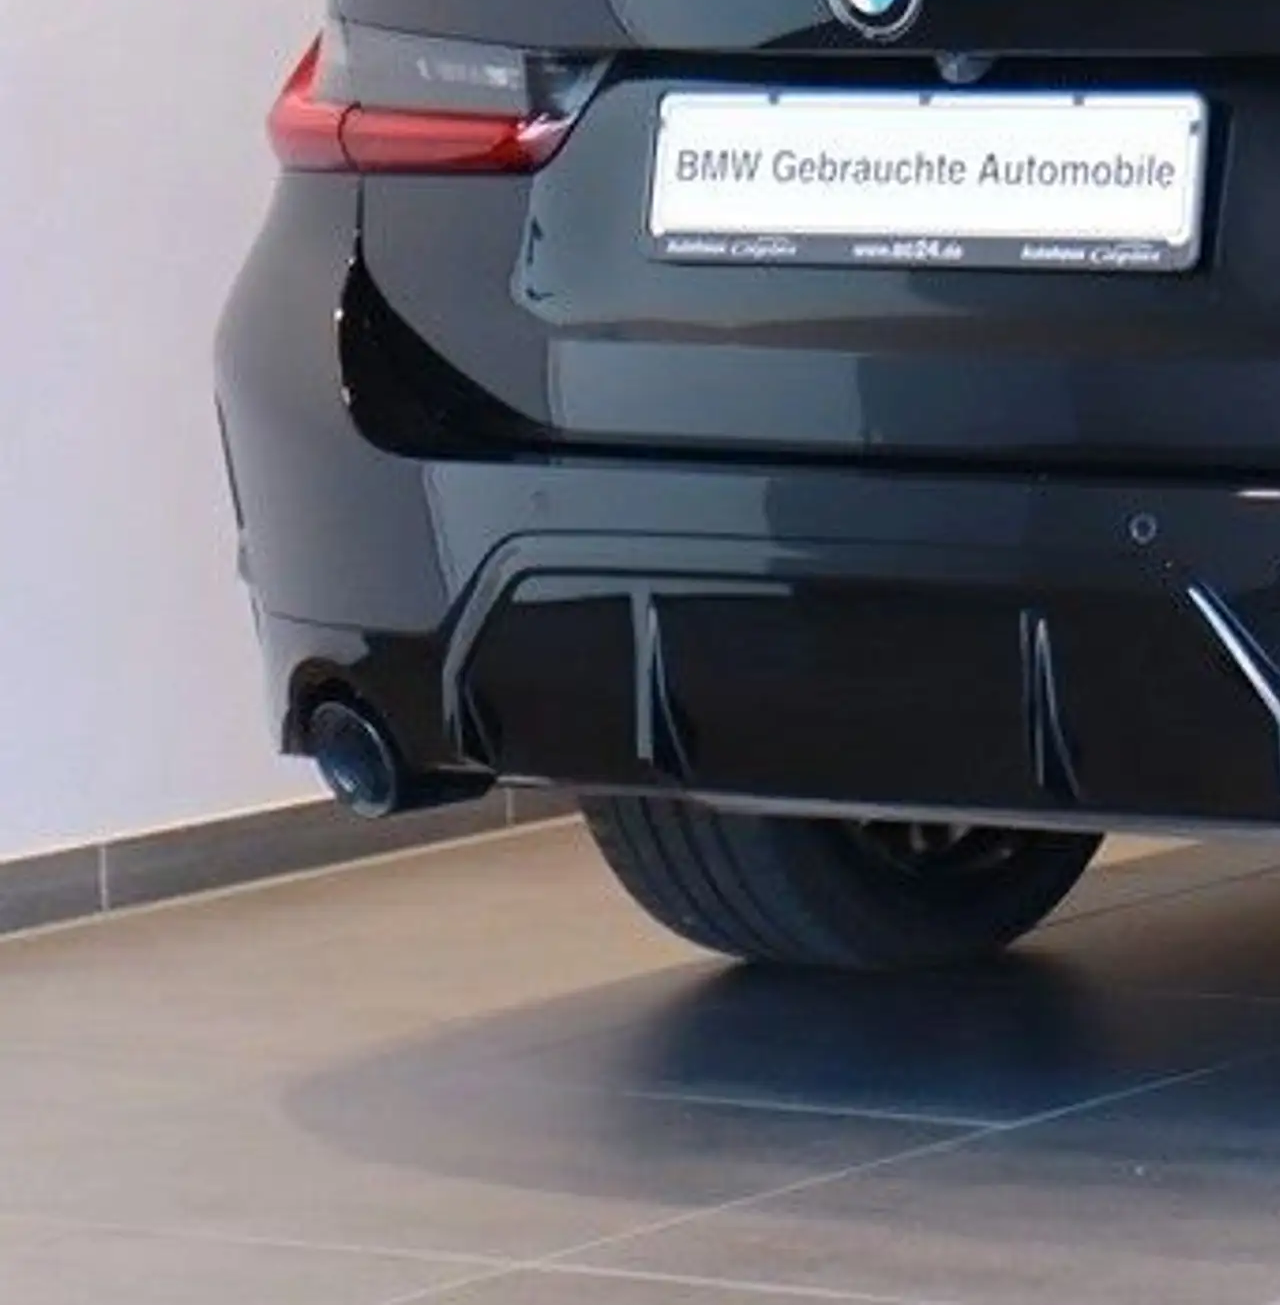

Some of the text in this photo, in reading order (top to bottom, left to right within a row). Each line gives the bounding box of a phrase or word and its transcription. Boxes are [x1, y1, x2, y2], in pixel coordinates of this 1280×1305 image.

[675, 148, 1177, 190] BMW Gebrauchte Automobile
